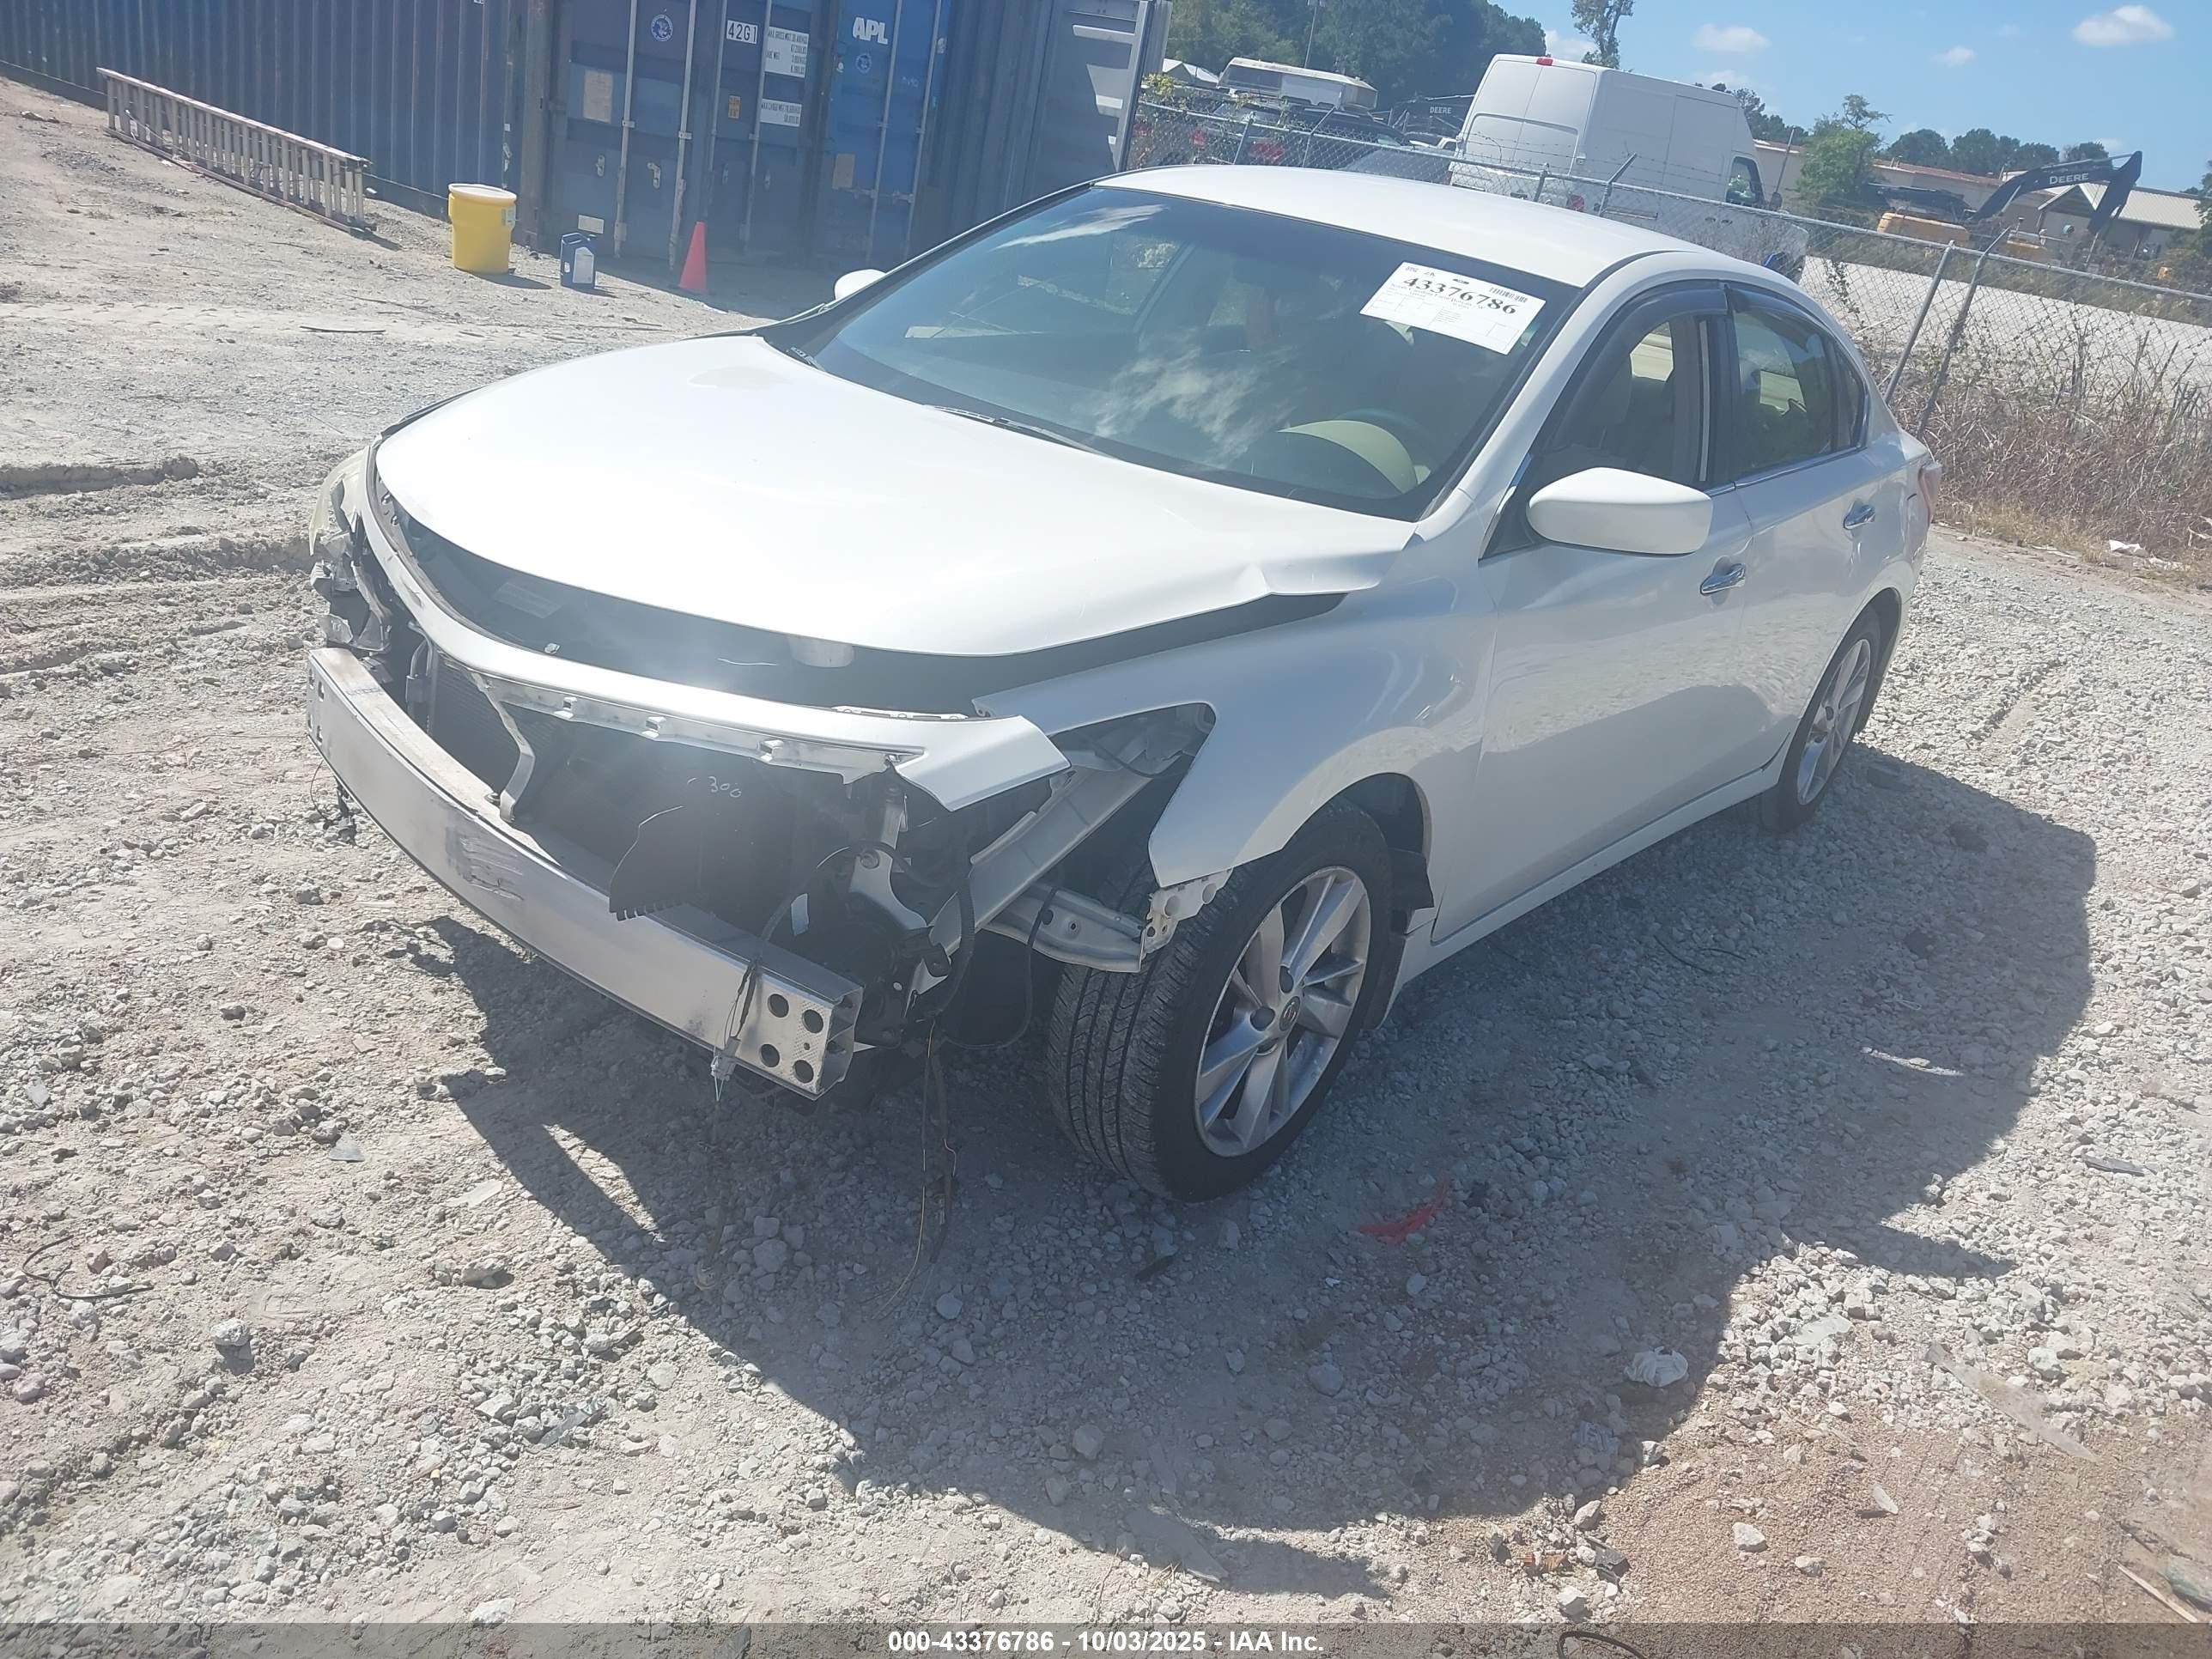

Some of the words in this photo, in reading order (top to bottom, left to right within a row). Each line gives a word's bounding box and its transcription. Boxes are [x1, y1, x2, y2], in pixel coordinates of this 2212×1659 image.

[728, 22, 757, 43] 42G1
[853, 16, 888, 45] APL
[2049, 173, 2089, 185] DEERE
[1403, 277, 1519, 314] 43376786
